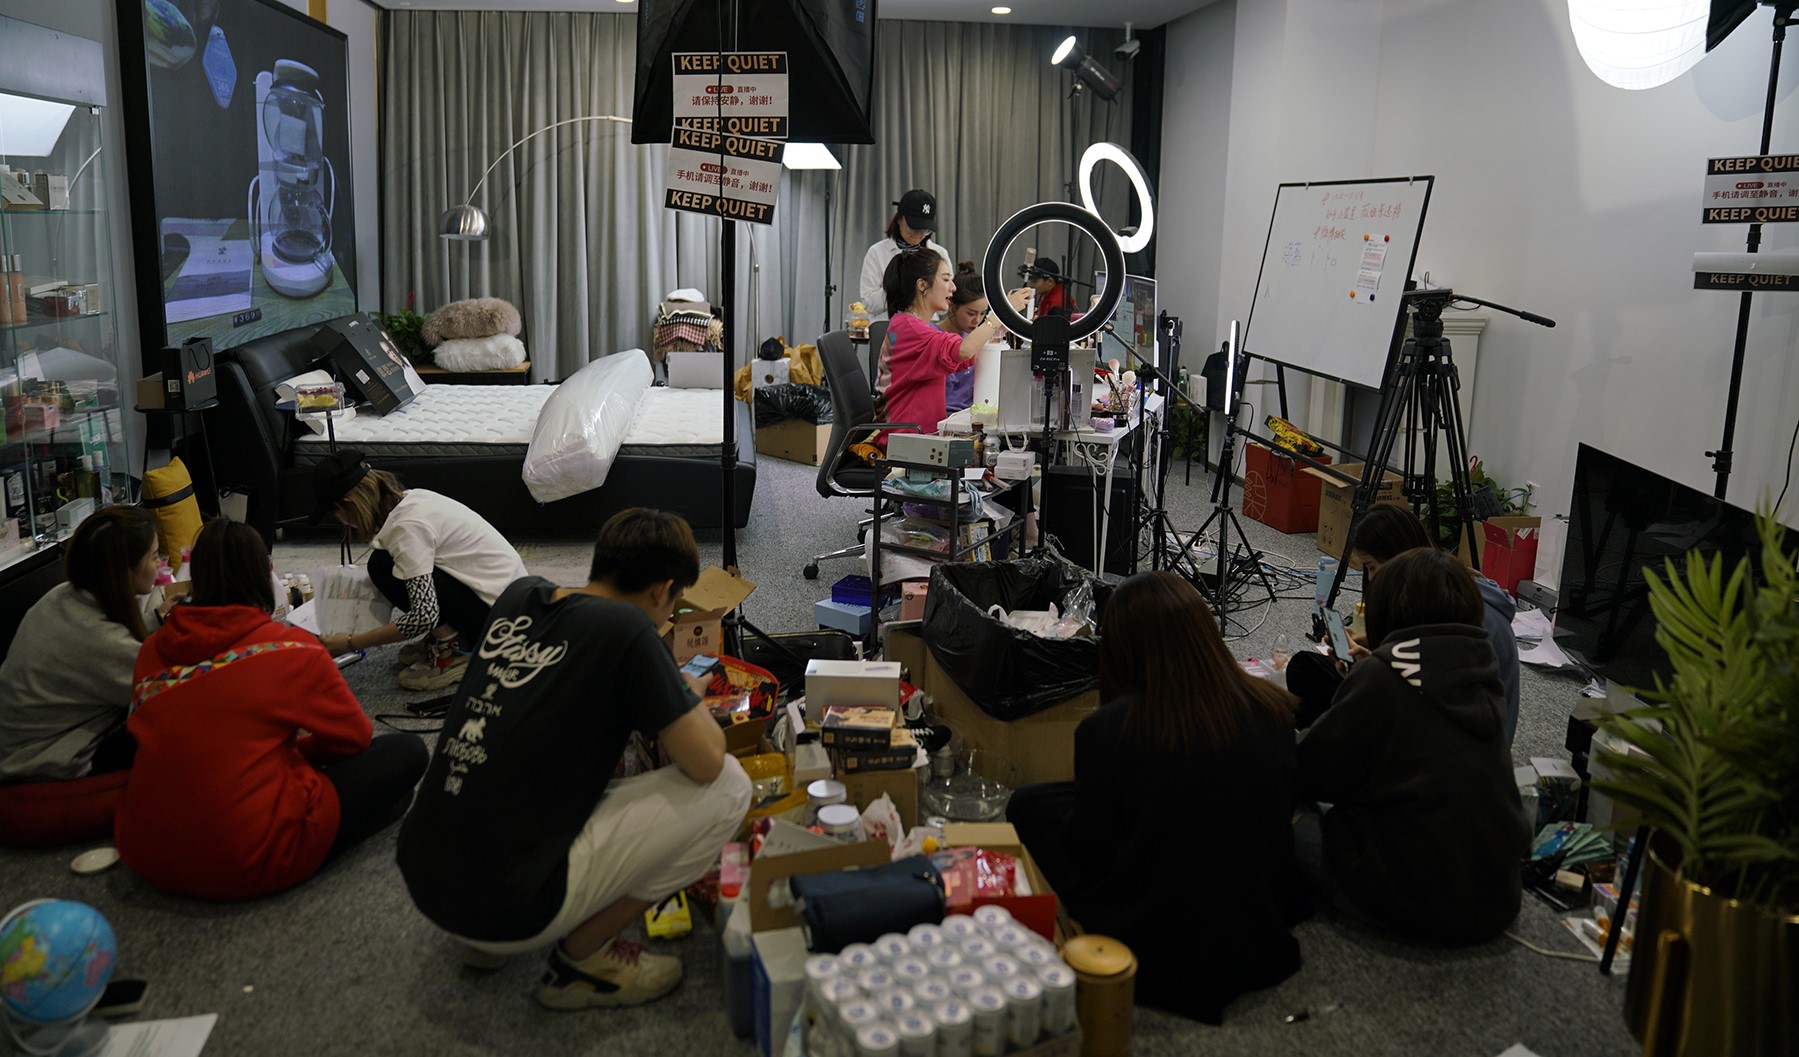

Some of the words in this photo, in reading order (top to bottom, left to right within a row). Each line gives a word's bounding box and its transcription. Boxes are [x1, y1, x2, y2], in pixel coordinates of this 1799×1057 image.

[680, 55, 723, 71] KEEP
[727, 55, 779, 73] QUIET
[681, 118, 724, 133] KEEP
[727, 118, 780, 135] QUIET
[679, 130, 722, 149] KEEP
[725, 137, 778, 158] QUIET
[730, 168, 750, 177] 直播中
[1714, 159, 1756, 172] KEEP
[671, 191, 713, 210] KEEP
[715, 198, 768, 219] QUIET
[1709, 208, 1751, 221] KEEP
[1755, 206, 1799, 222] QUIE
[1710, 273, 1744, 284] KEEP
[1748, 274, 1792, 287] QUIET
